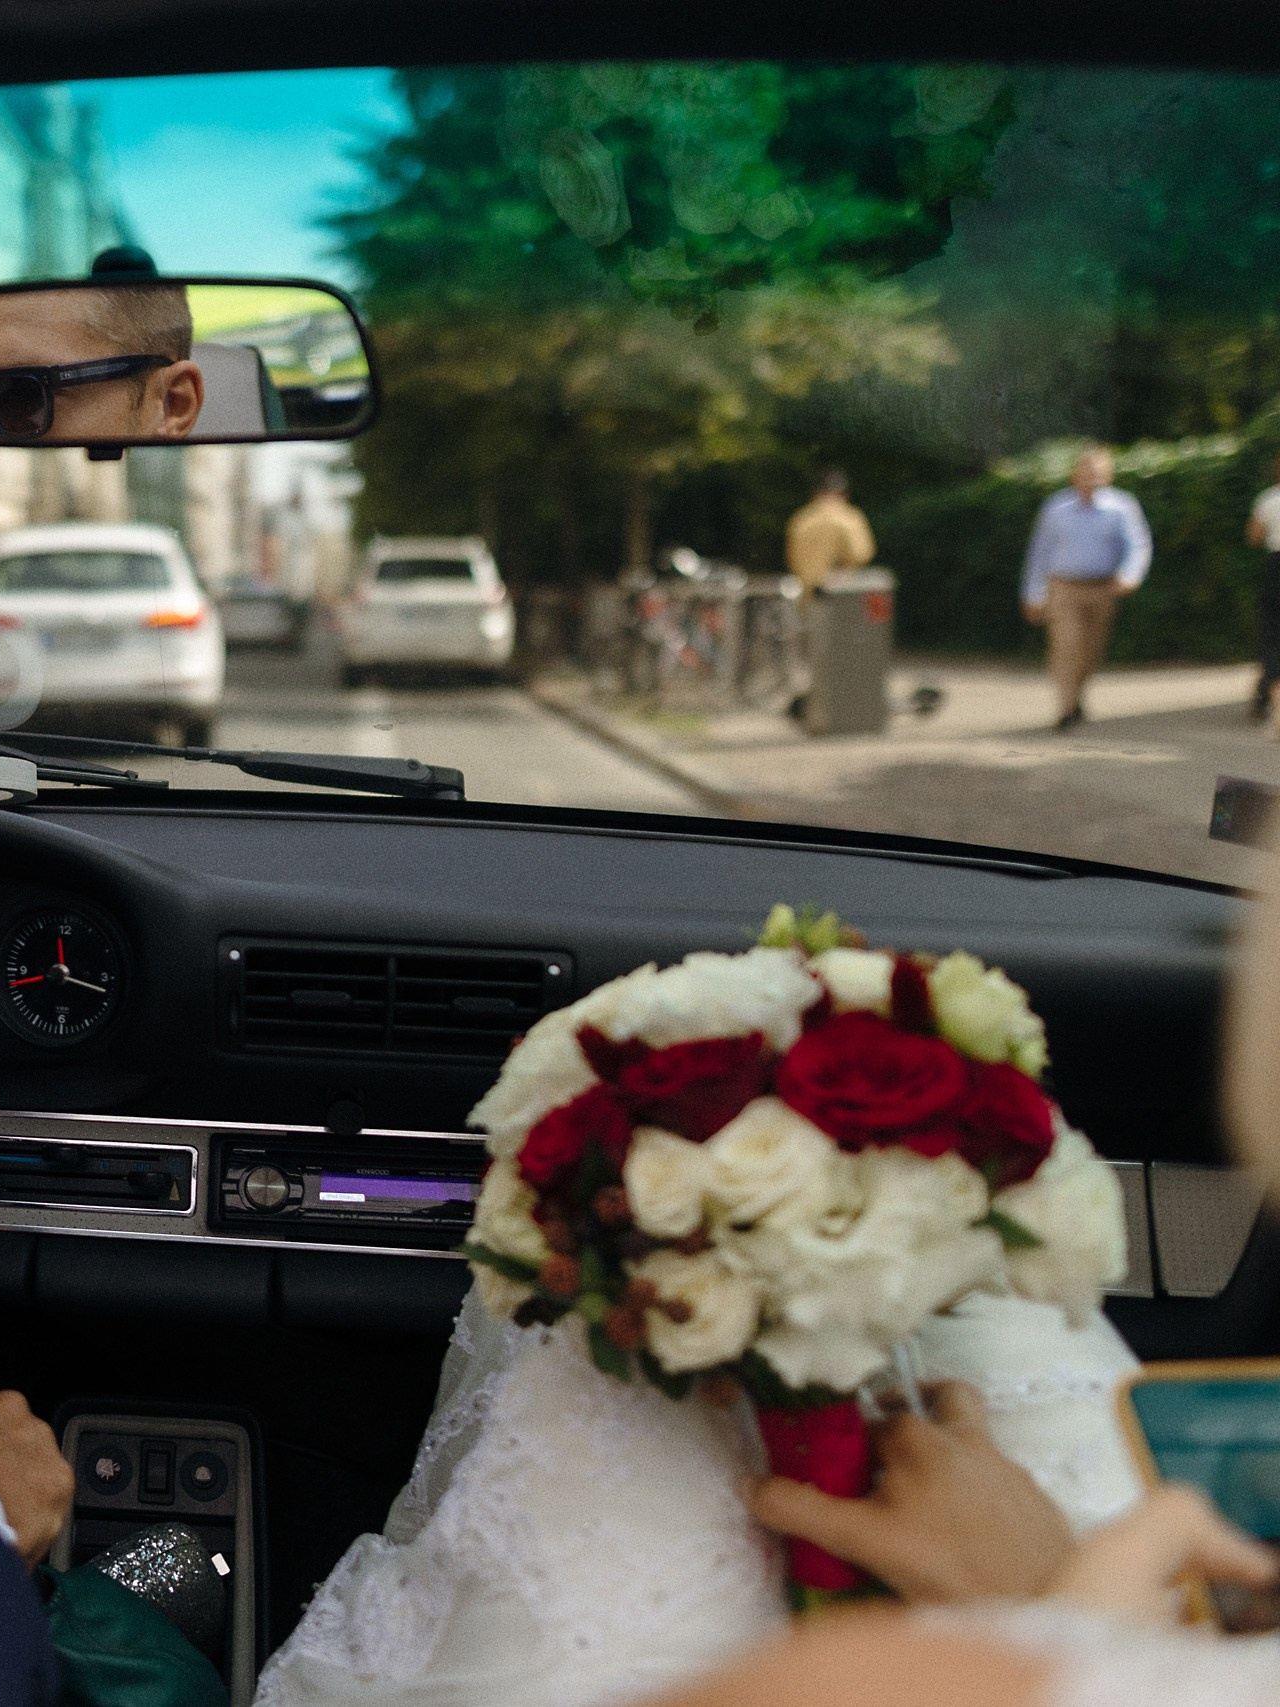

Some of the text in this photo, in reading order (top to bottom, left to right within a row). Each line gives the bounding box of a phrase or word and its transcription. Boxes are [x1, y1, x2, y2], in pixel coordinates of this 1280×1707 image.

[59, 925, 72, 935] 12
[19, 965, 28, 975] 9
[100, 972, 109, 982] 3
[57, 1014, 66, 1024] 6
[356, 1168, 390, 1176] KENWOOD
